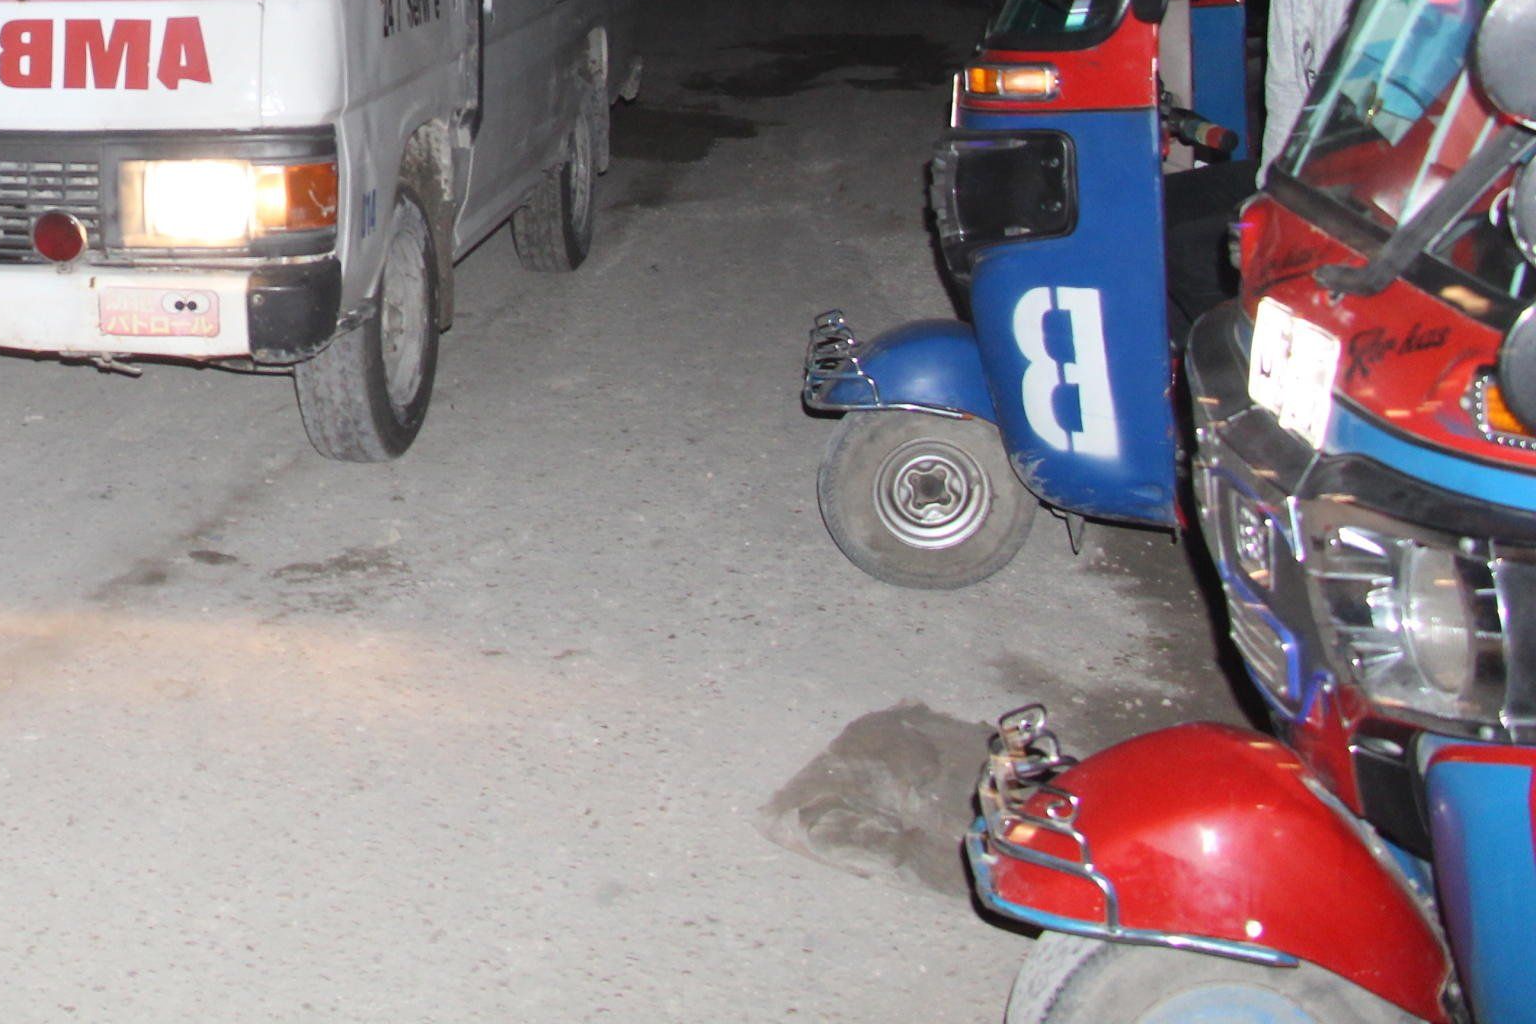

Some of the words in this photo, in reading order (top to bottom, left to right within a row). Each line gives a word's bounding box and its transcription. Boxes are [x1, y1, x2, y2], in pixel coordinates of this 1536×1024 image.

[106, 315, 215, 335] パトロール
